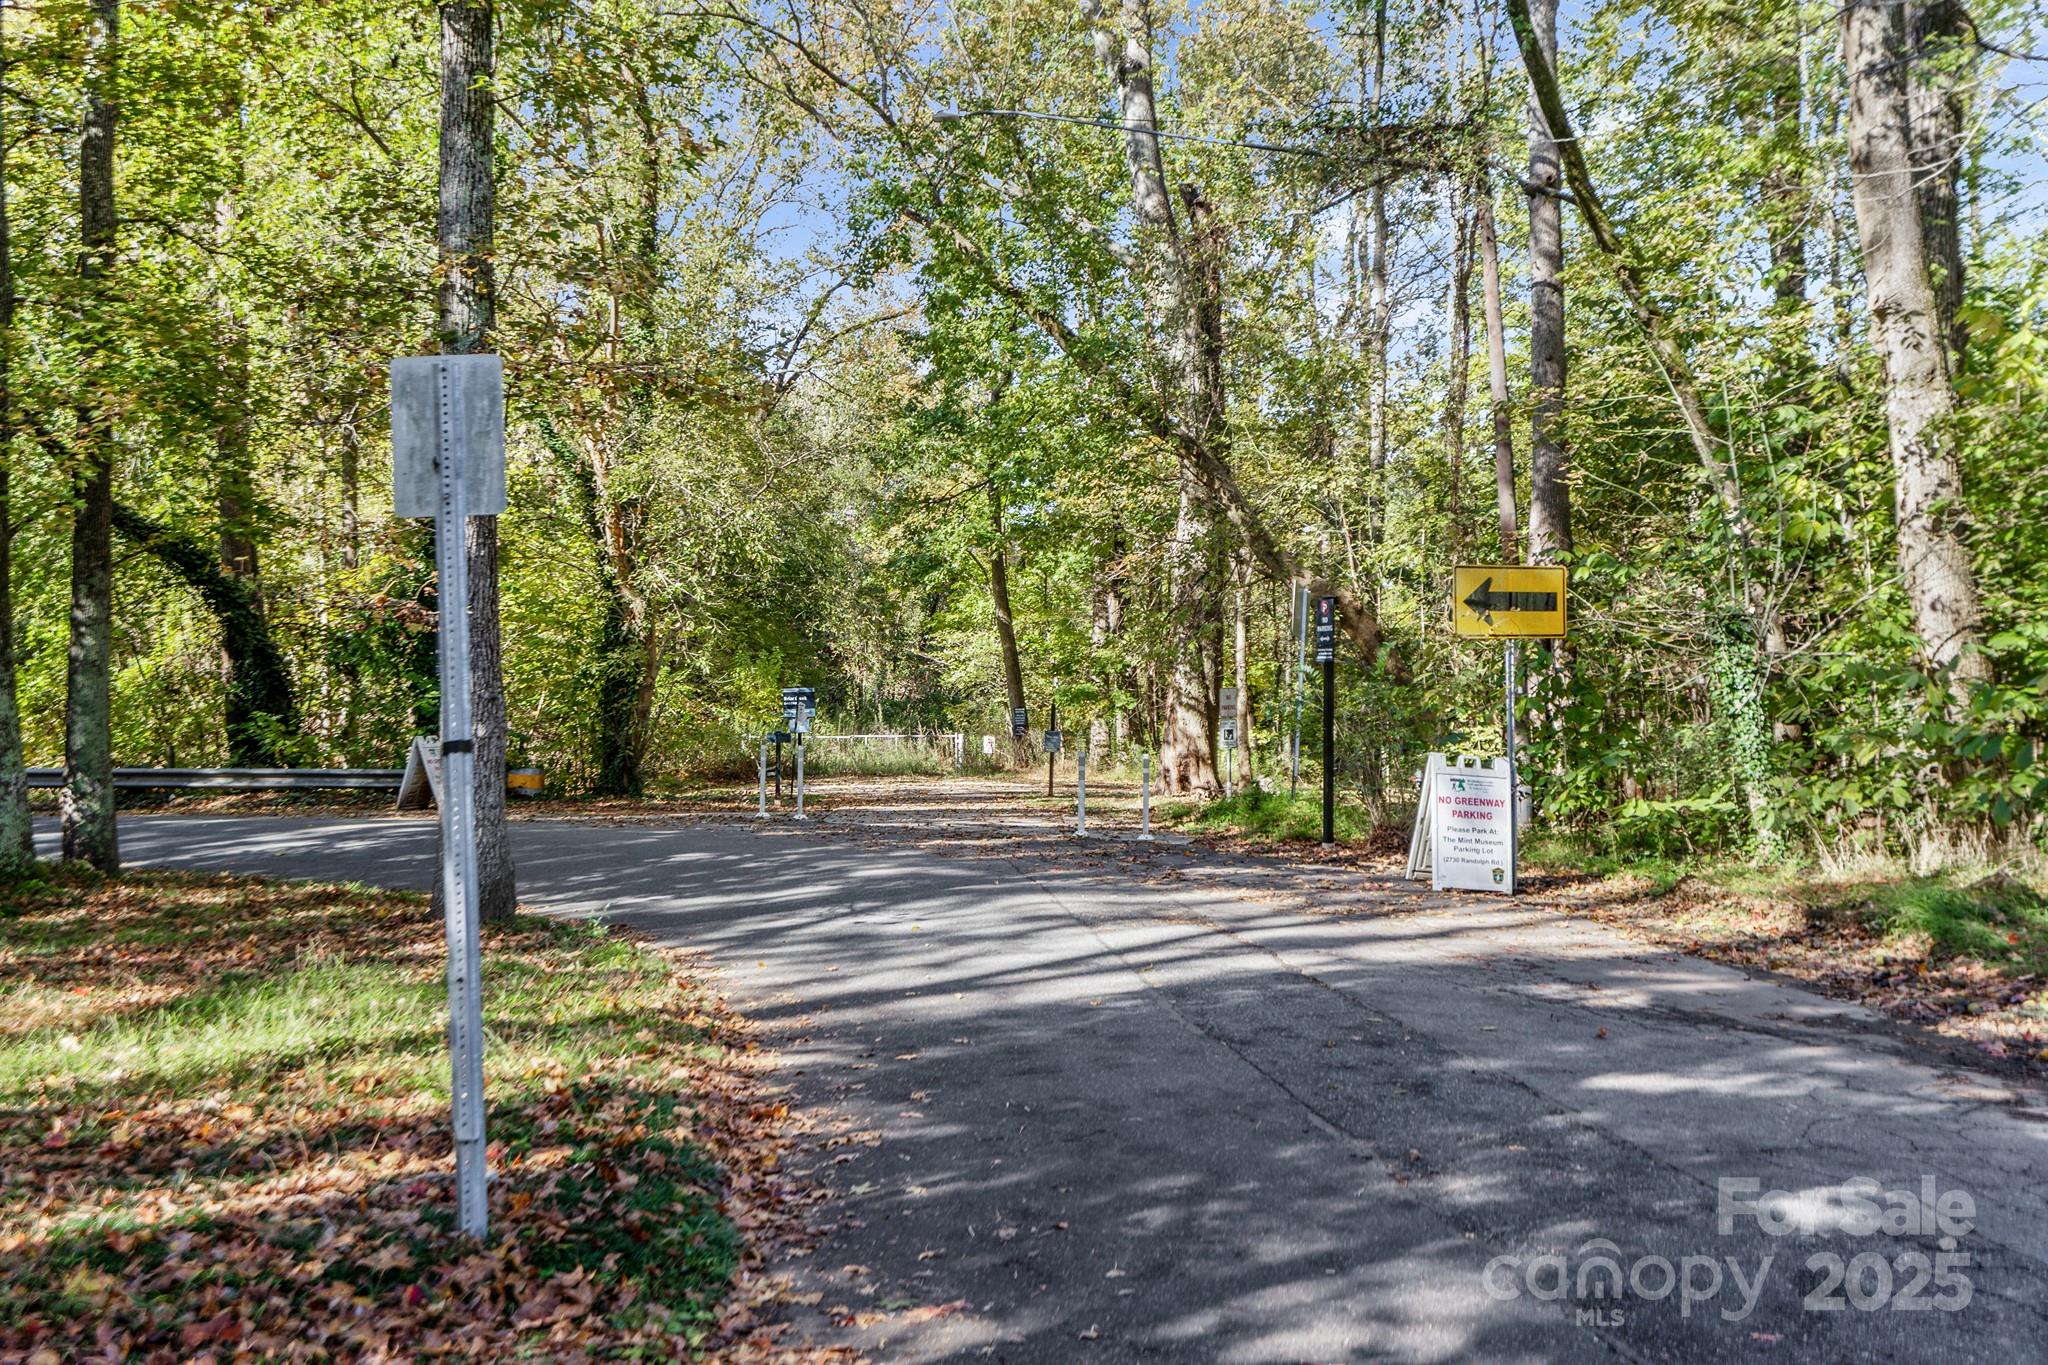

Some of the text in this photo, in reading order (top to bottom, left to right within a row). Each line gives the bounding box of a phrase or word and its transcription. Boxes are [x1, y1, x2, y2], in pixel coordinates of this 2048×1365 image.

[1438, 796, 1506, 808] NO GREENWAY
[1452, 810, 1493, 820] PARKING
[1475, 838, 1504, 846] Museum
[1453, 846, 1480, 855] Parking
[1461, 857, 1489, 865] Randolph
